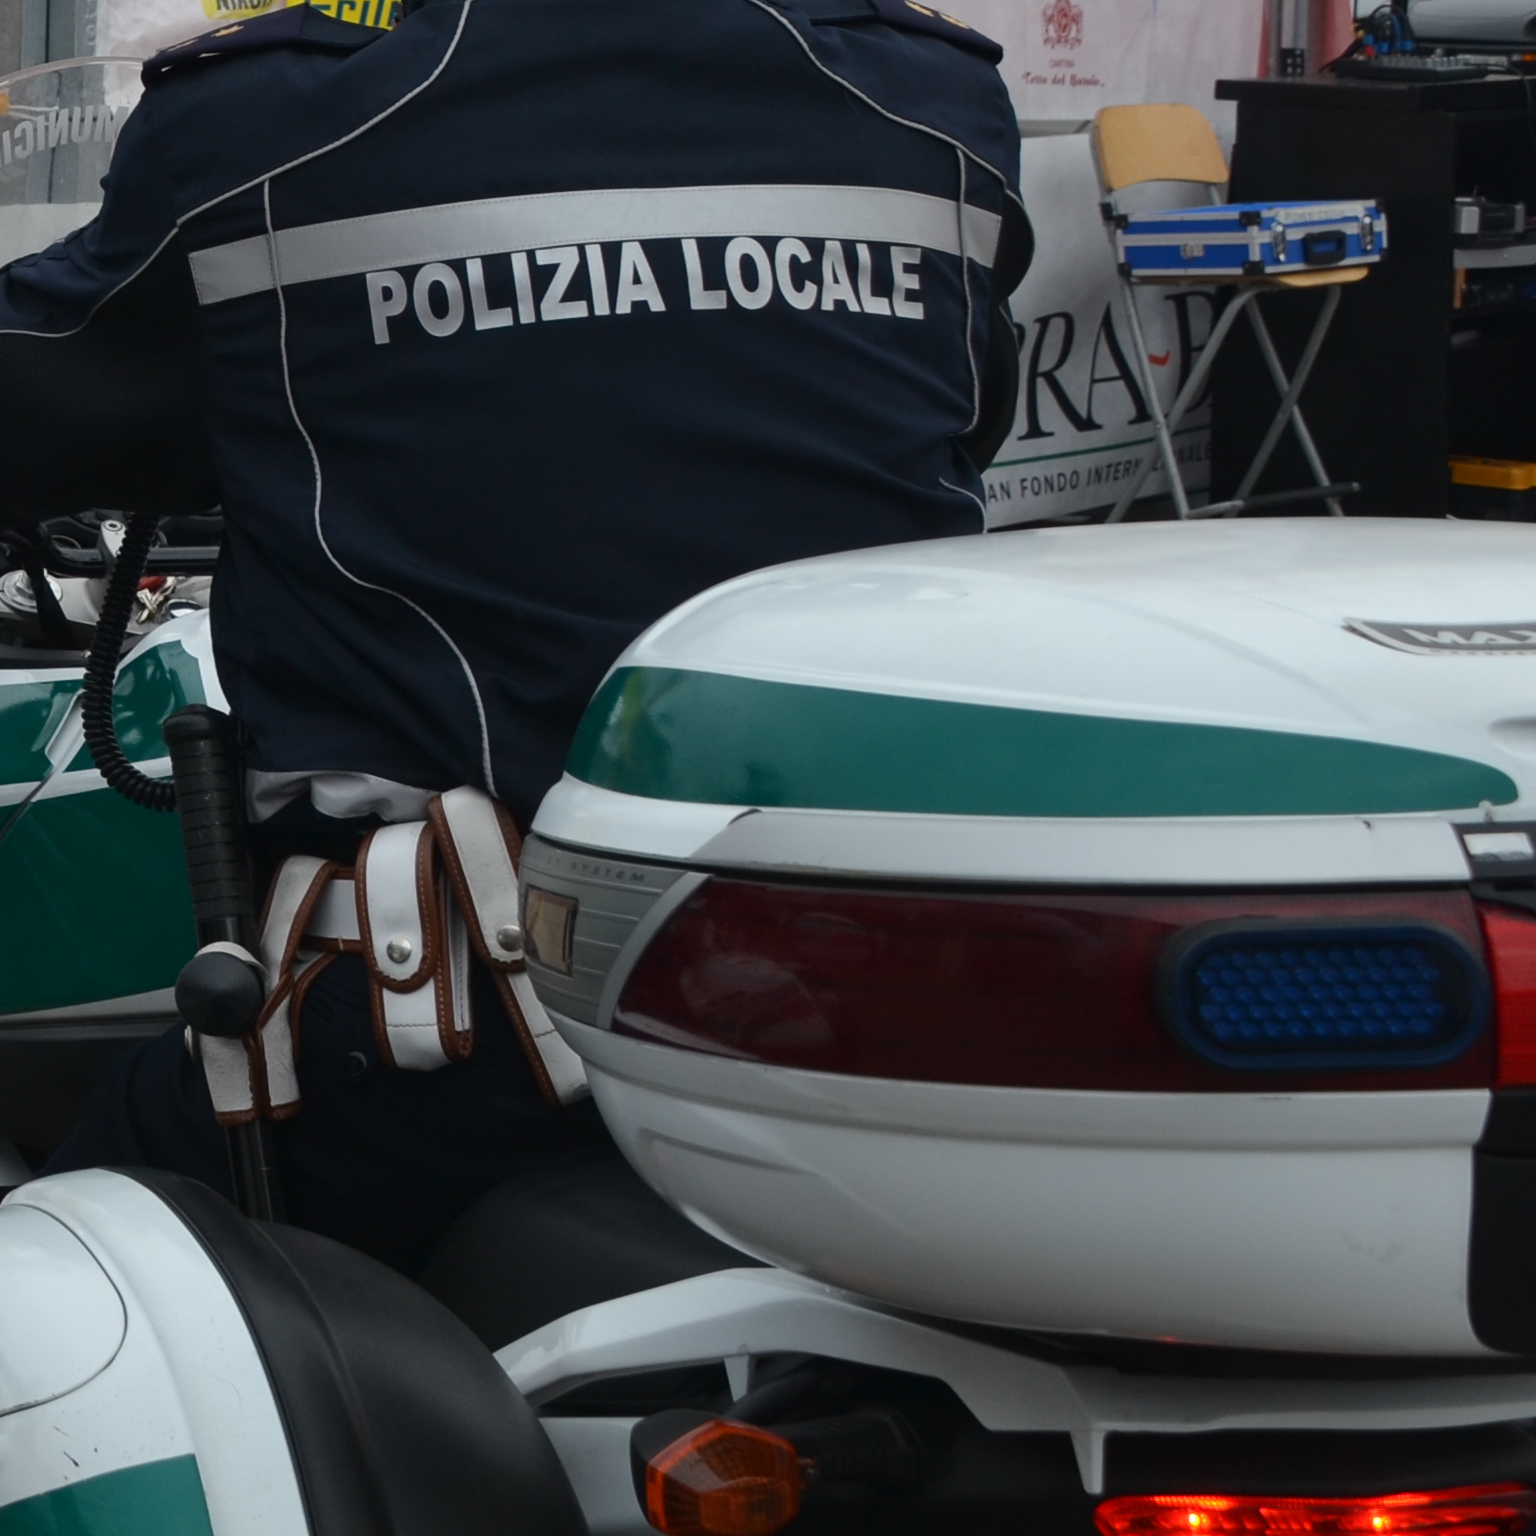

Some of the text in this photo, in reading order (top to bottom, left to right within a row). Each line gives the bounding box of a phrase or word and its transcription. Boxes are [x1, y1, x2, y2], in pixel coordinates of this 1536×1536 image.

[365, 235, 927, 346] POLIZIA LOCALE
[1014, 302, 1154, 441] RA
[1019, 470, 1080, 499] FONDO
[570, 861, 646, 882] SYSTEM
